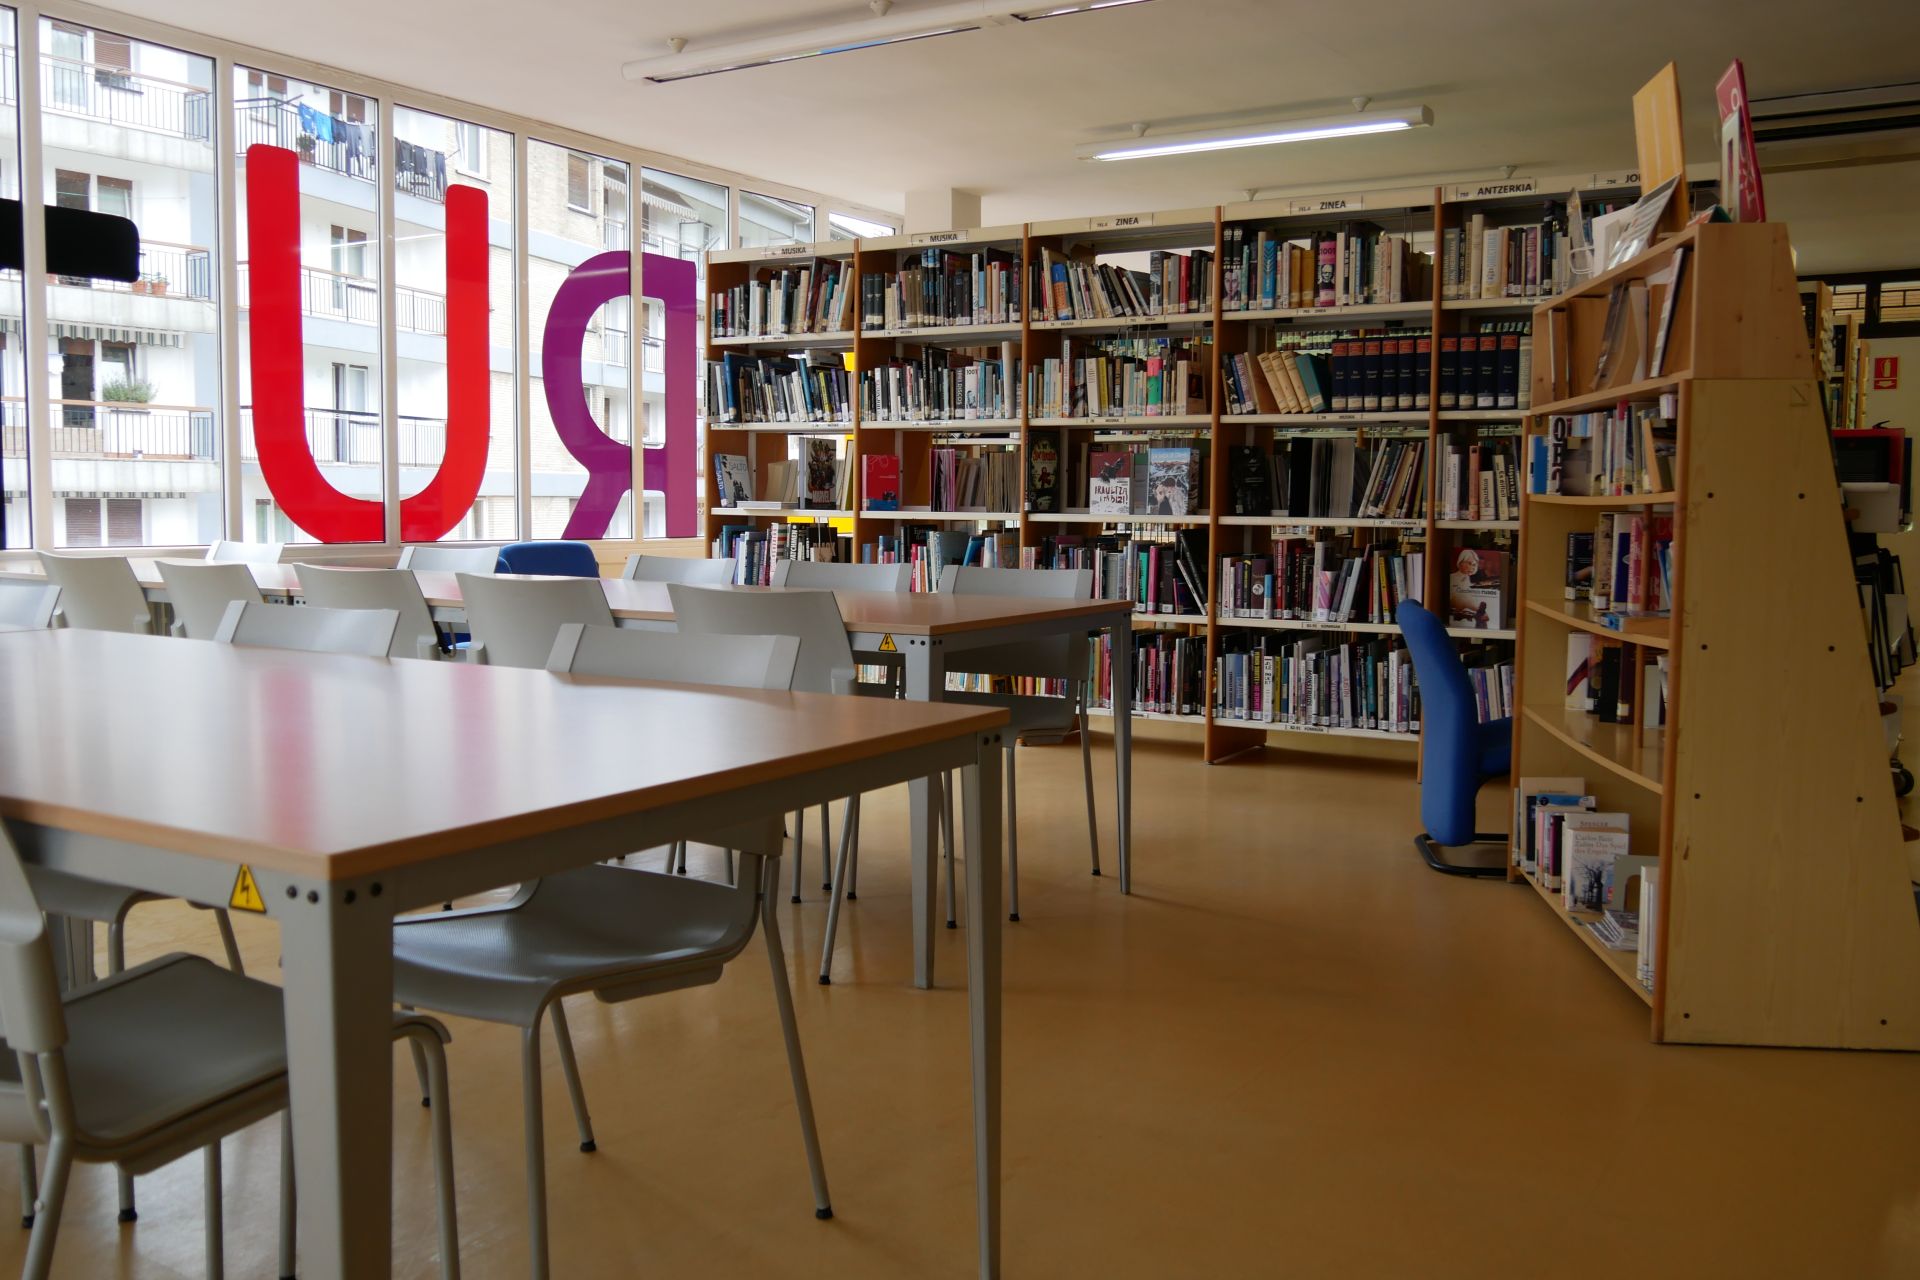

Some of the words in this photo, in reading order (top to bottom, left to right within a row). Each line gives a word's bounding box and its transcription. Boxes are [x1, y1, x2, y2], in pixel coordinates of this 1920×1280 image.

[1477, 183, 1532, 196] ANTZERKIA
[1319, 200, 1346, 210] ZINEA
[1115, 217, 1139, 226] ZINEA
[929, 233, 958, 243] MUSIKA
[781, 246, 807, 255] MUSIKA
